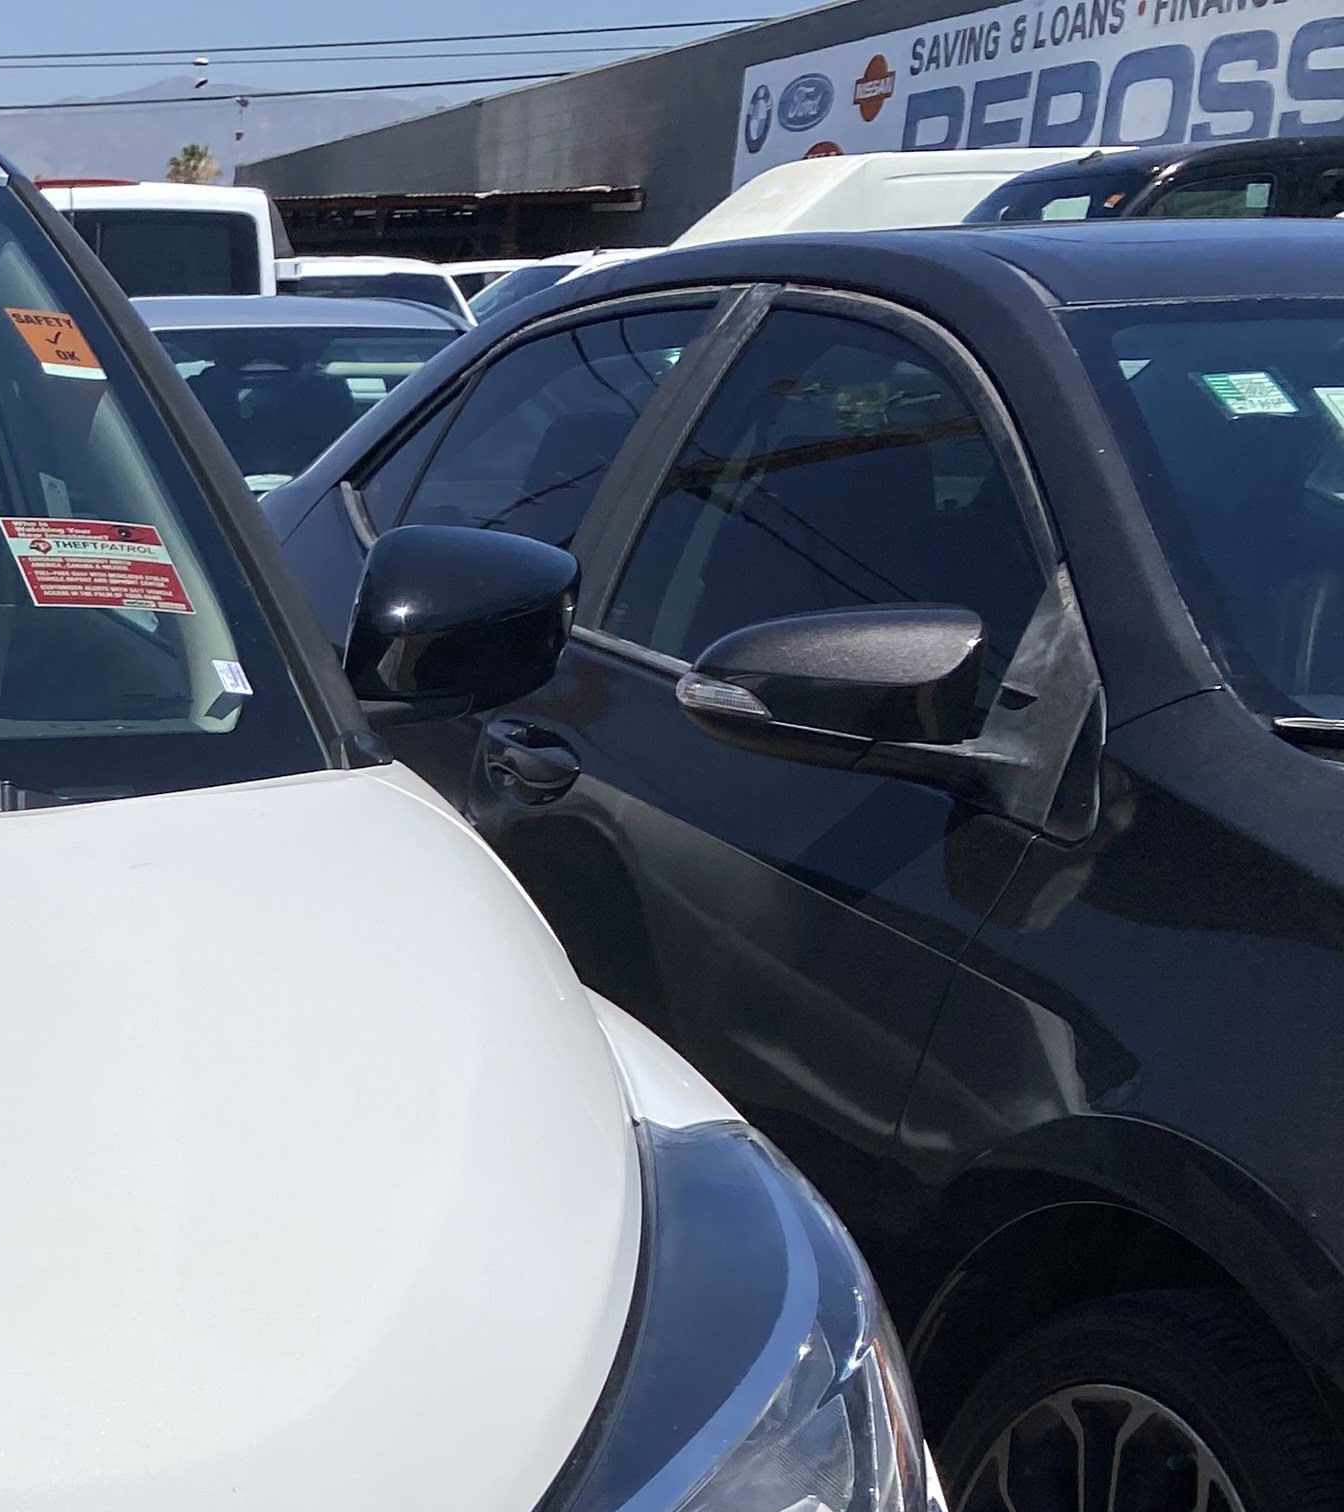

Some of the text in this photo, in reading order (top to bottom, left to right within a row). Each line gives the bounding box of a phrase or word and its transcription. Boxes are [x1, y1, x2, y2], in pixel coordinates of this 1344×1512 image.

[910, 21, 1002, 76] SAVING
[1010, 14, 1027, 53] &
[1032, 0, 1127, 50] LOANS
[12, 313, 74, 329] SAFETY
[55, 349, 80, 362] OK
